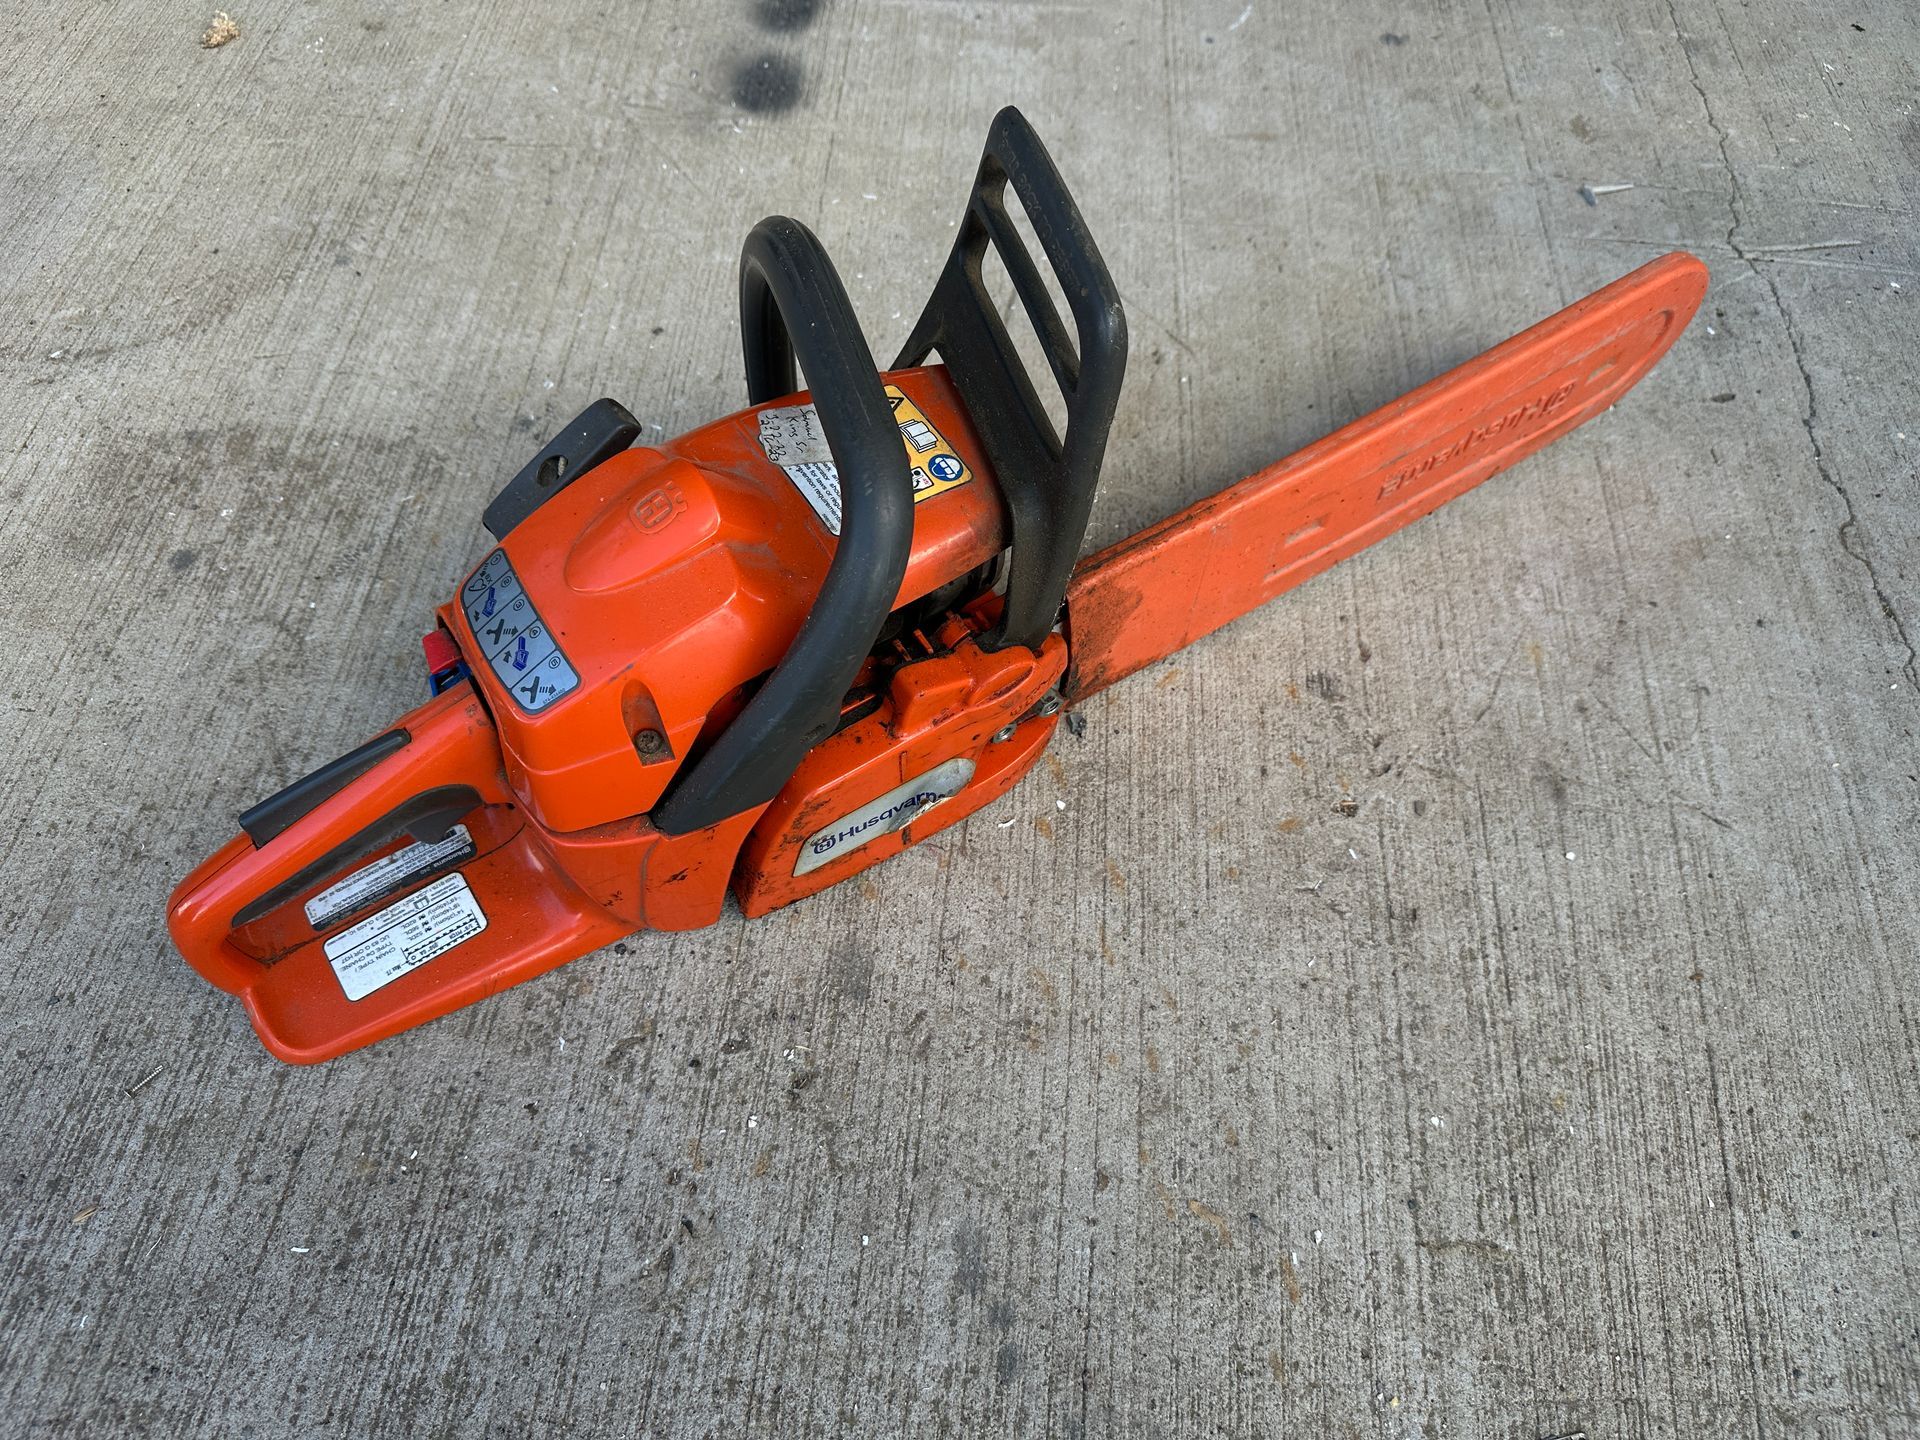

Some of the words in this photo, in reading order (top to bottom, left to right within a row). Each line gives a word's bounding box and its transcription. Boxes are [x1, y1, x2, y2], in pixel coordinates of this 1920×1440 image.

[809, 468, 818, 479] for
[815, 476, 827, 491] laws
[825, 489, 832, 497] or
[838, 789, 950, 842] Husqvarn
[432, 848, 464, 868] Husqvarna
[356, 919, 374, 931] CLASS
[378, 934, 390, 942] UC
[448, 929, 462, 939] PITCH
[353, 948, 364, 956] OR
[374, 940, 392, 952] TYPE
[374, 946, 396, 961] CHAIN
[357, 957, 375, 970] TYPE
[391, 964, 401, 972] Max
